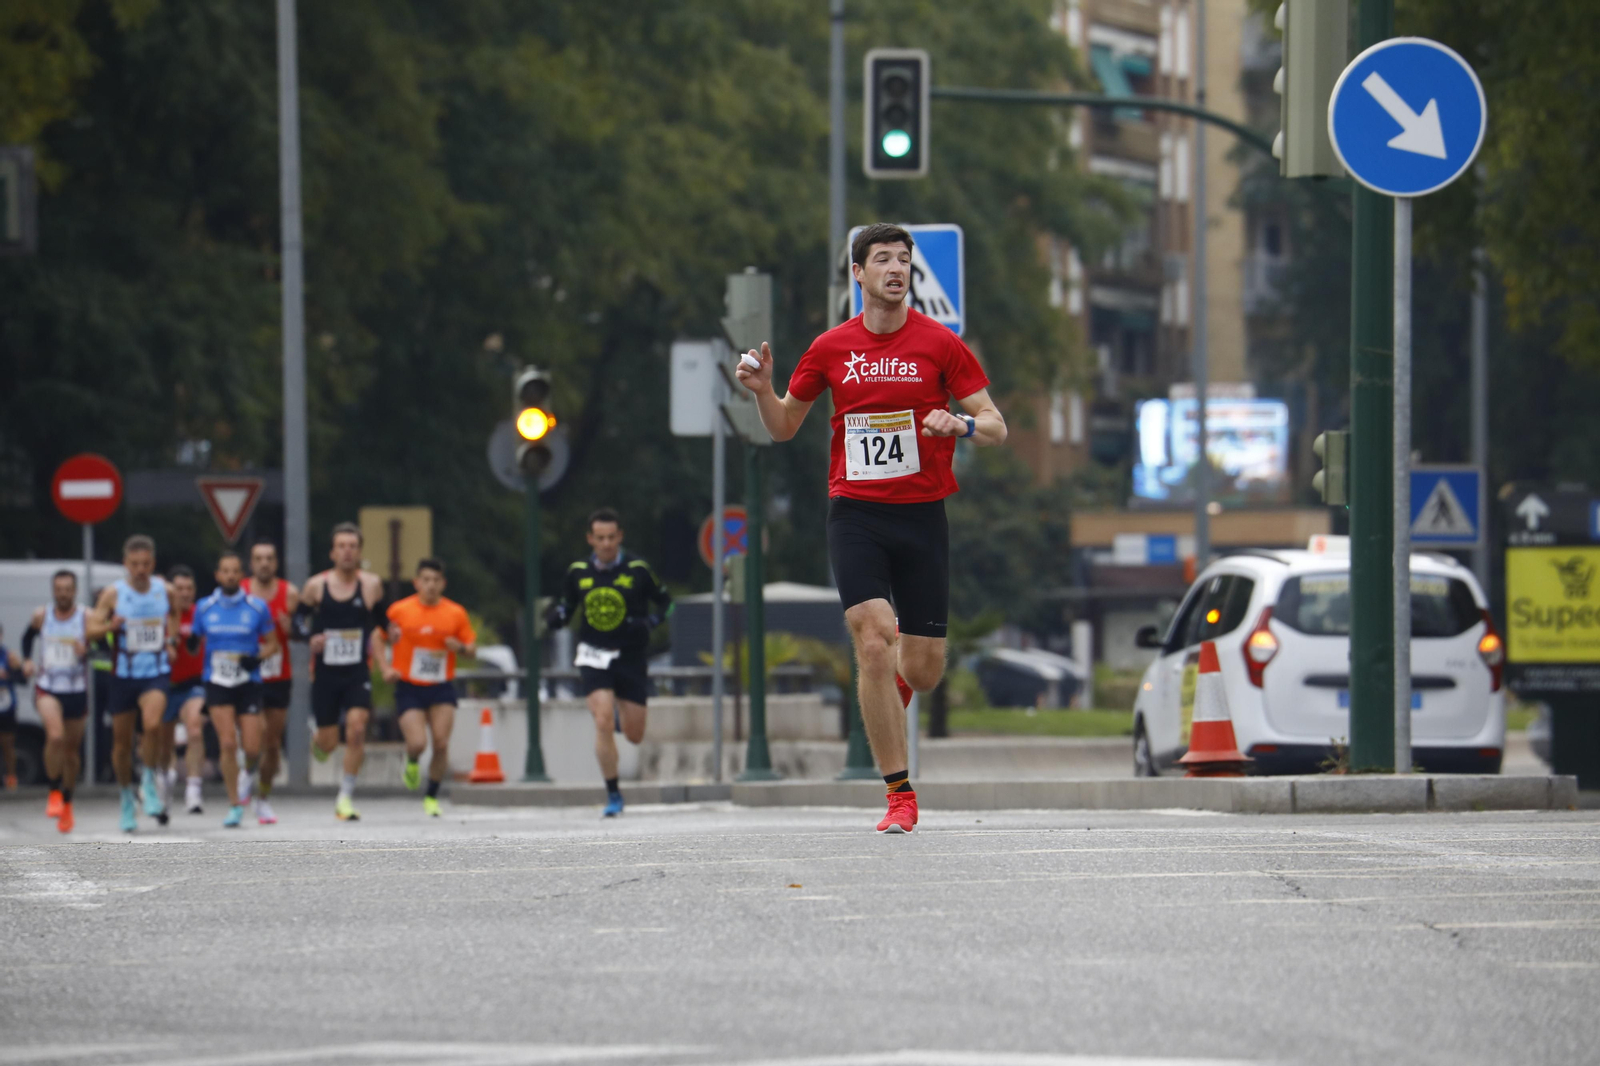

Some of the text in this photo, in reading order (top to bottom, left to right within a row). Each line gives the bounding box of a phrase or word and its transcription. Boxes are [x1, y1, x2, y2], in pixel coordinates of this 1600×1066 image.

[860, 357, 918, 376] califas
[847, 416, 870, 428] XXXIX
[860, 434, 904, 466] 124
